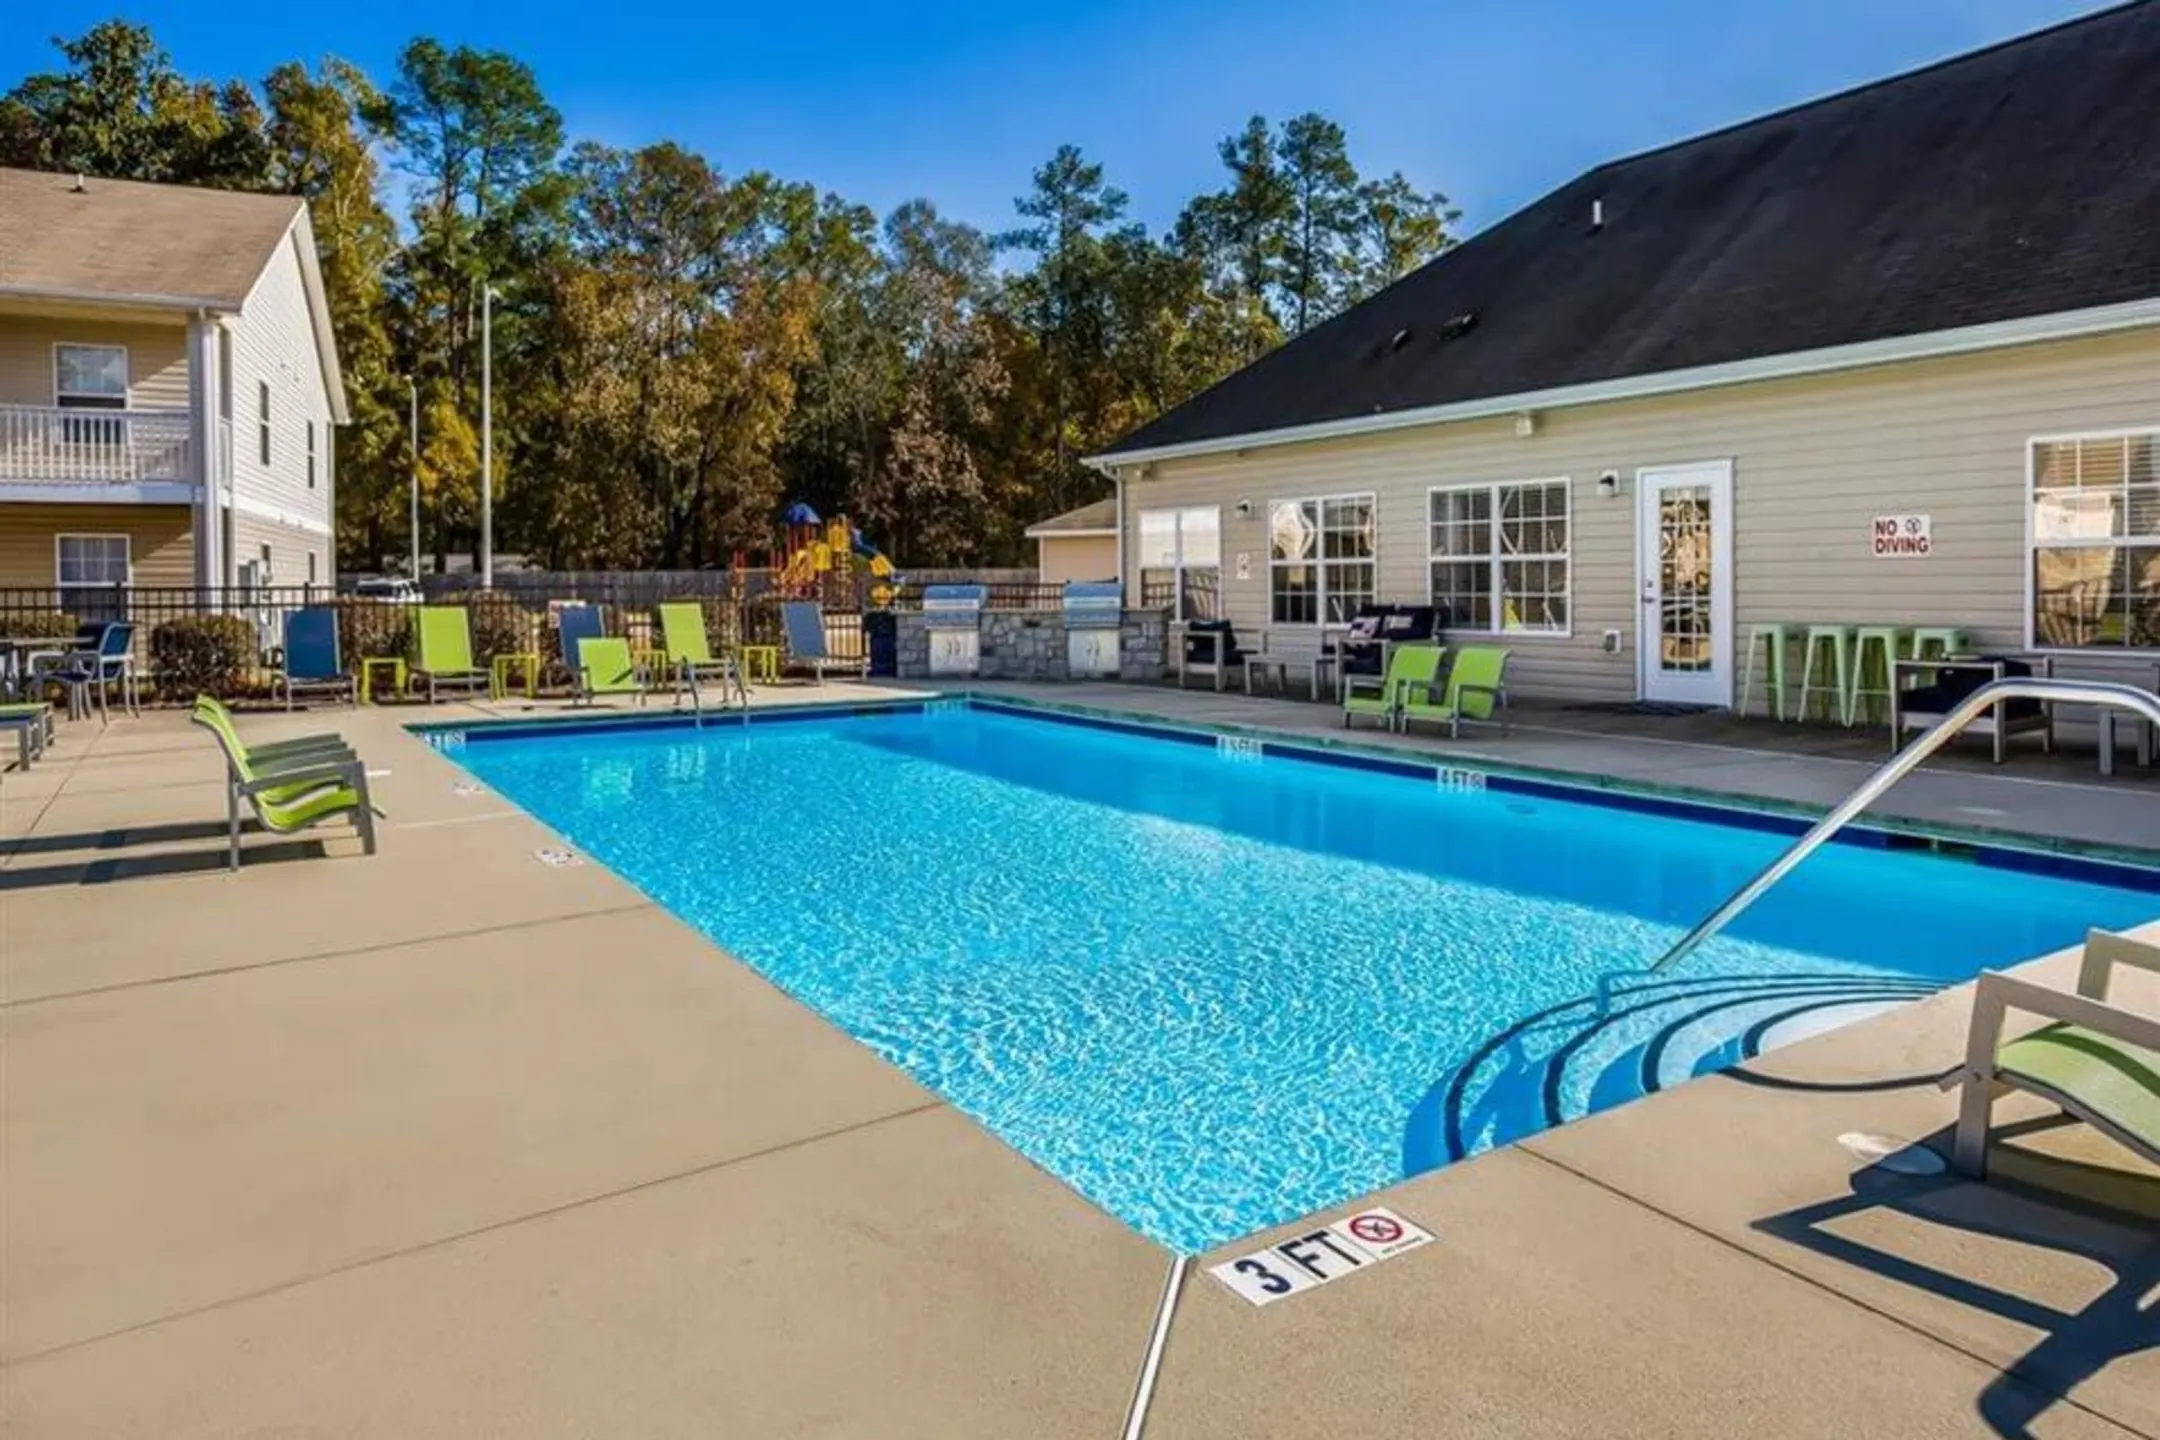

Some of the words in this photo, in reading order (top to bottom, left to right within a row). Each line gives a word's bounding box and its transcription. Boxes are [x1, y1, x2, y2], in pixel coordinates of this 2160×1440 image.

[1876, 519, 1898, 536] NO
[1875, 536, 1929, 554] DIVING
[1233, 1258, 1292, 1294] 3
[1276, 1229, 1361, 1280] FT
